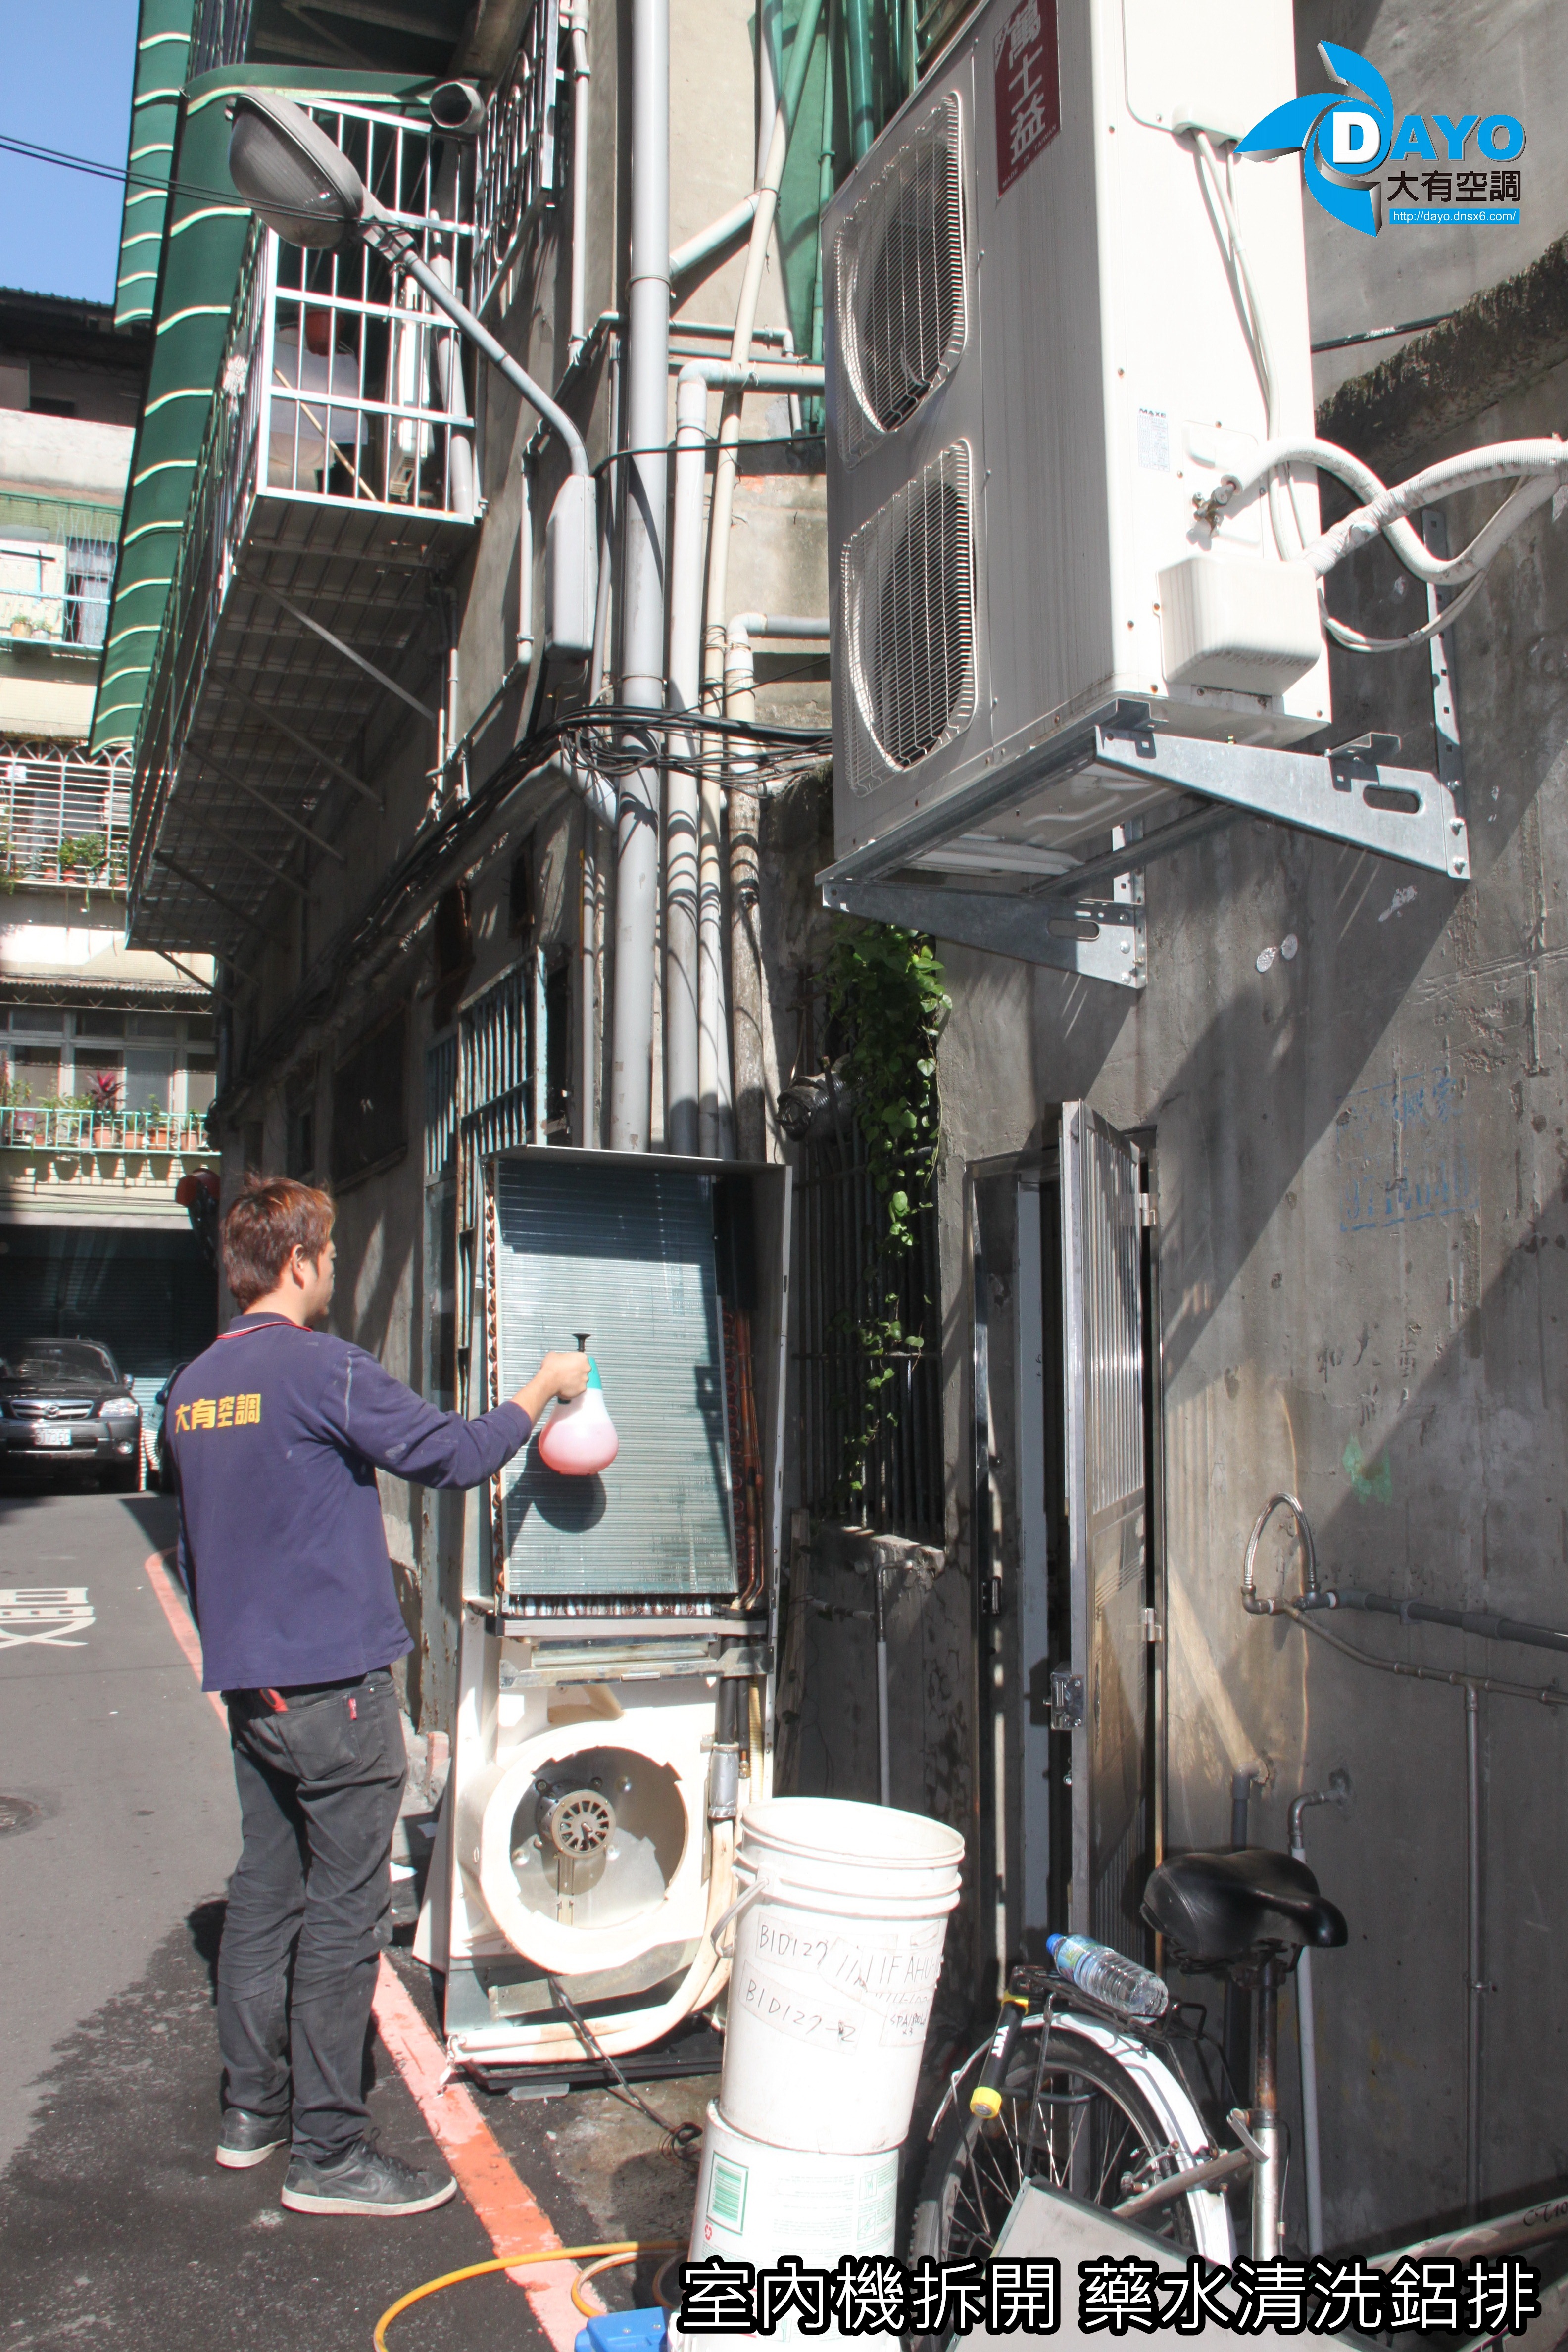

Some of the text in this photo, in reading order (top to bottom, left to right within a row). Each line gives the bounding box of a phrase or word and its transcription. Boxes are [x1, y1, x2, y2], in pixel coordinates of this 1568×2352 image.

[1007, 0, 1046, 165] 萬士益
[1002, 124, 1056, 189] MADE IN TAIWAN
[1139, 408, 1166, 419] MAXE
[175, 1393, 261, 1434] 大有空調
